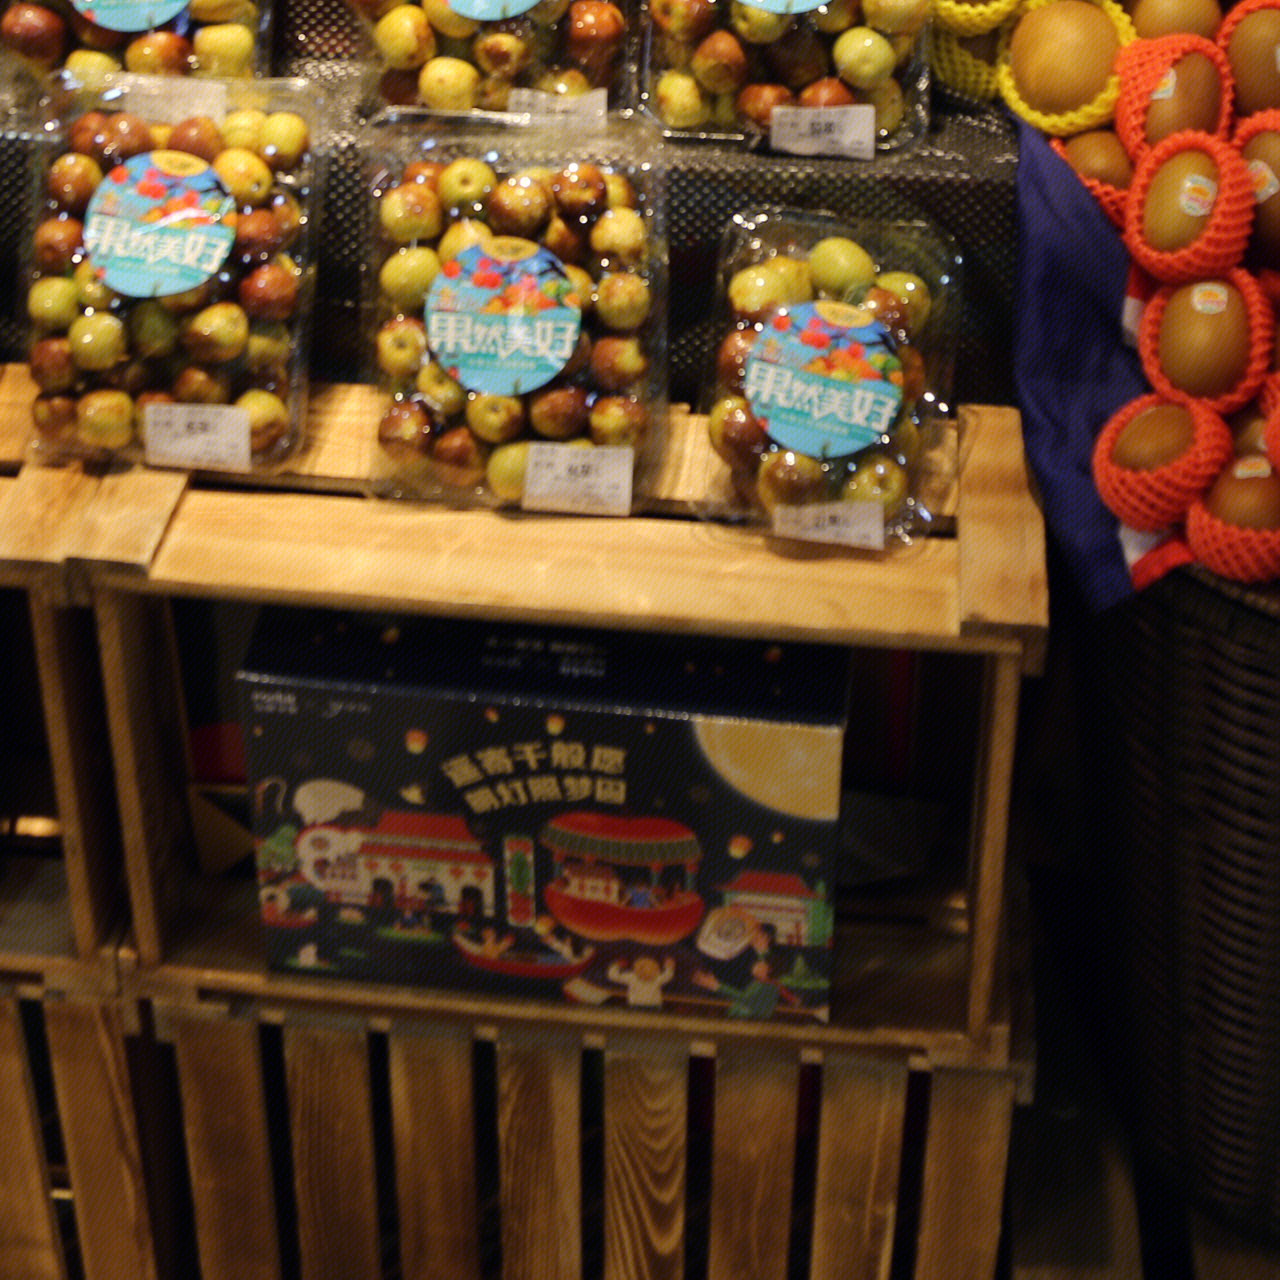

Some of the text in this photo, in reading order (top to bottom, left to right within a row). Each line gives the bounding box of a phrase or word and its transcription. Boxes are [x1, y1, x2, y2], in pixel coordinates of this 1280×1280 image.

[86, 218, 230, 271] 果然美好
[429, 315, 581, 361] 果然美好
[746, 360, 899, 431] 果然美好
